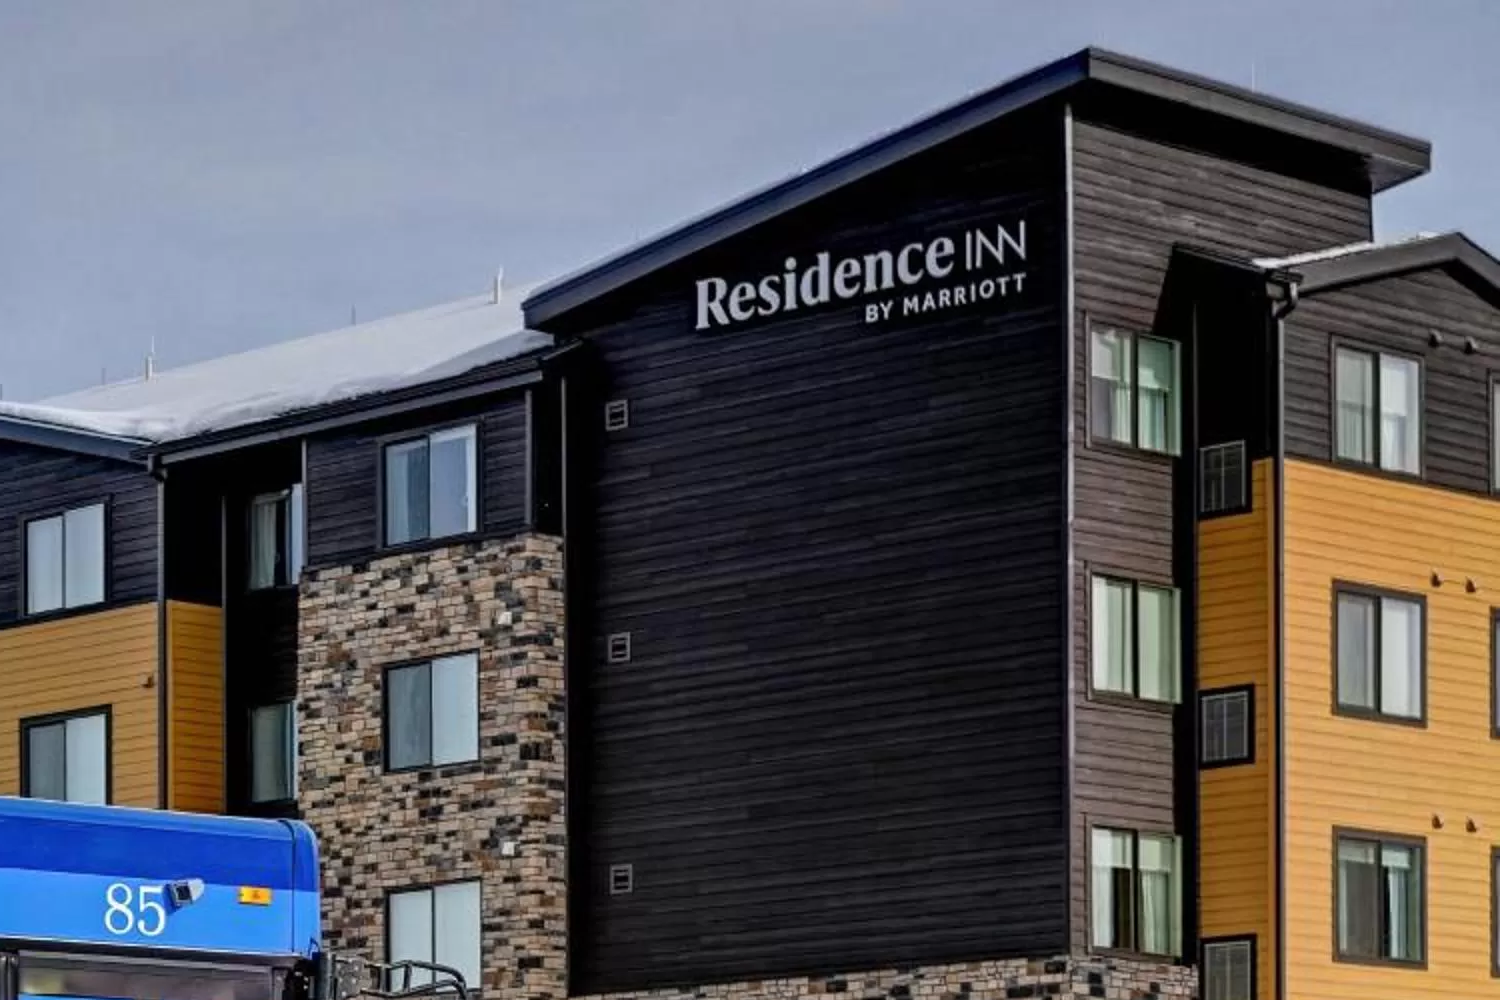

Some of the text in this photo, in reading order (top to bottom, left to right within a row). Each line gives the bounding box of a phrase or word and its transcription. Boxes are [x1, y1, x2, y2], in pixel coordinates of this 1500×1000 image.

[695, 220, 1027, 330] Residence INN
[864, 272, 1027, 324] BY MARRIOTT
[104, 882, 167, 937] 85
